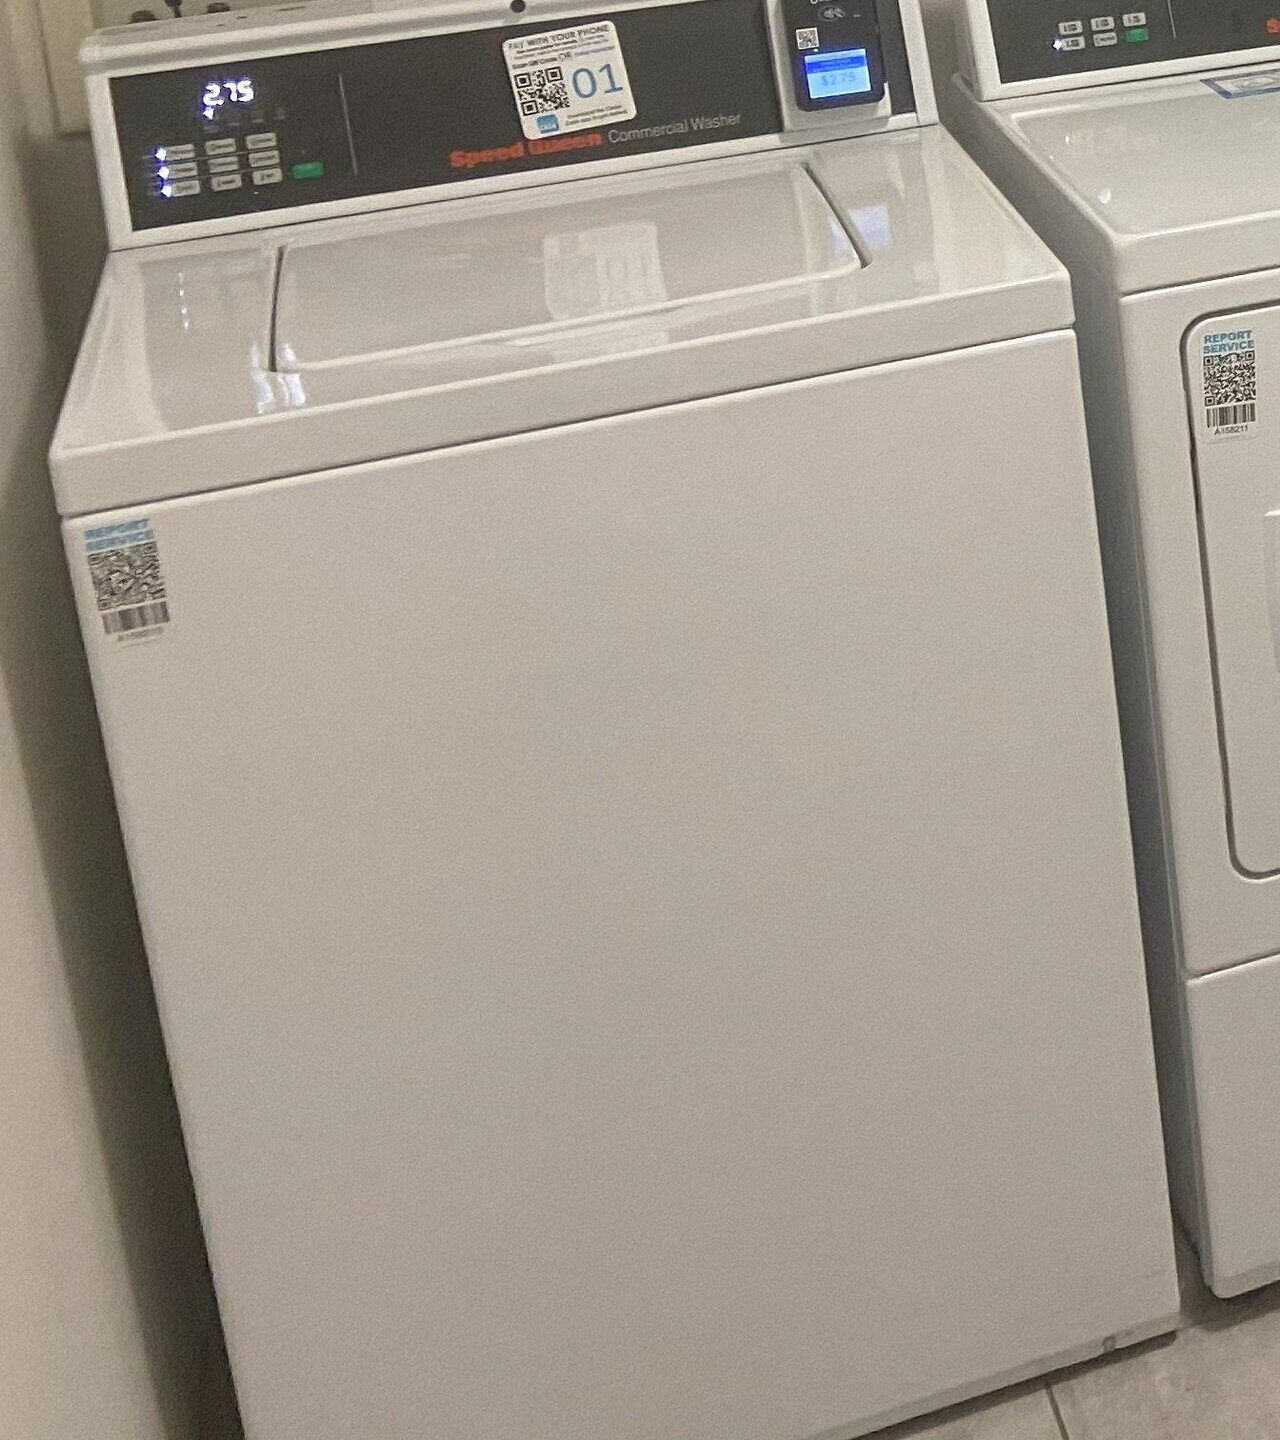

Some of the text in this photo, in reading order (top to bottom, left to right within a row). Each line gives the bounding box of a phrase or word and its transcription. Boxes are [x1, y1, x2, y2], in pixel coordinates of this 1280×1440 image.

[572, 63, 623, 99] 01
[608, 121, 689, 145] Commercial
[692, 112, 742, 132] Washer
[1203, 340, 1255, 354] SERVICE
[1204, 330, 1252, 344] REPORT
